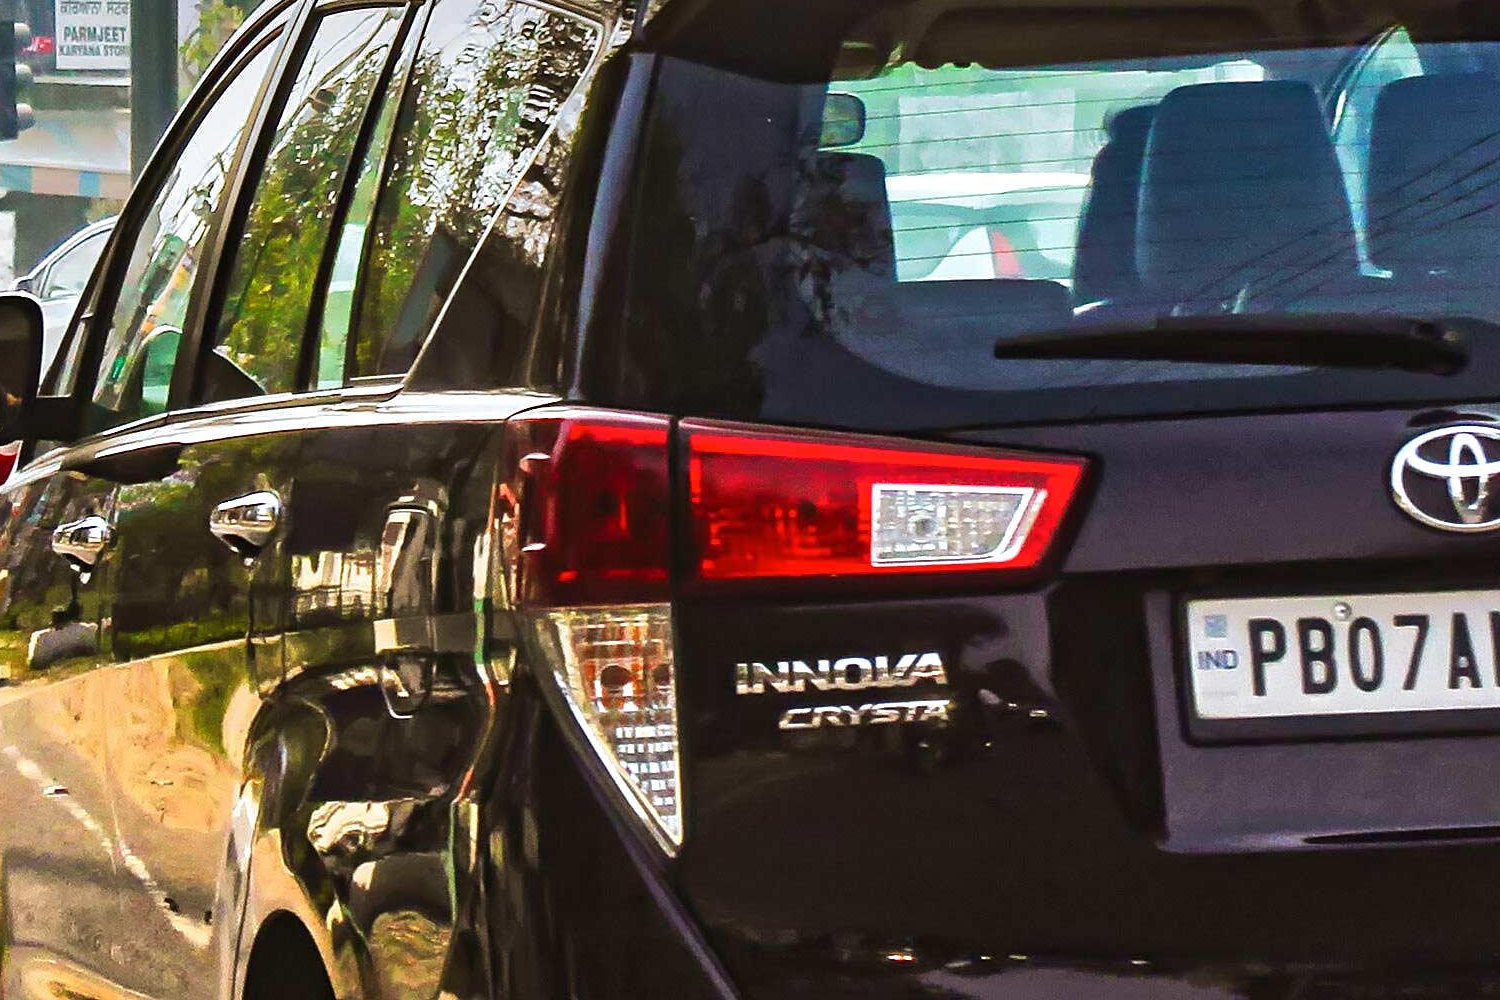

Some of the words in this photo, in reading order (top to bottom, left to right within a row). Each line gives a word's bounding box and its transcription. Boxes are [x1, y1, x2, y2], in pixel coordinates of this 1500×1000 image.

[63, 26, 127, 42] PARMJEET
[1197, 649, 1239, 670] IND
[735, 652, 948, 695] INNOVA
[778, 699, 950, 729] CRYSTA
